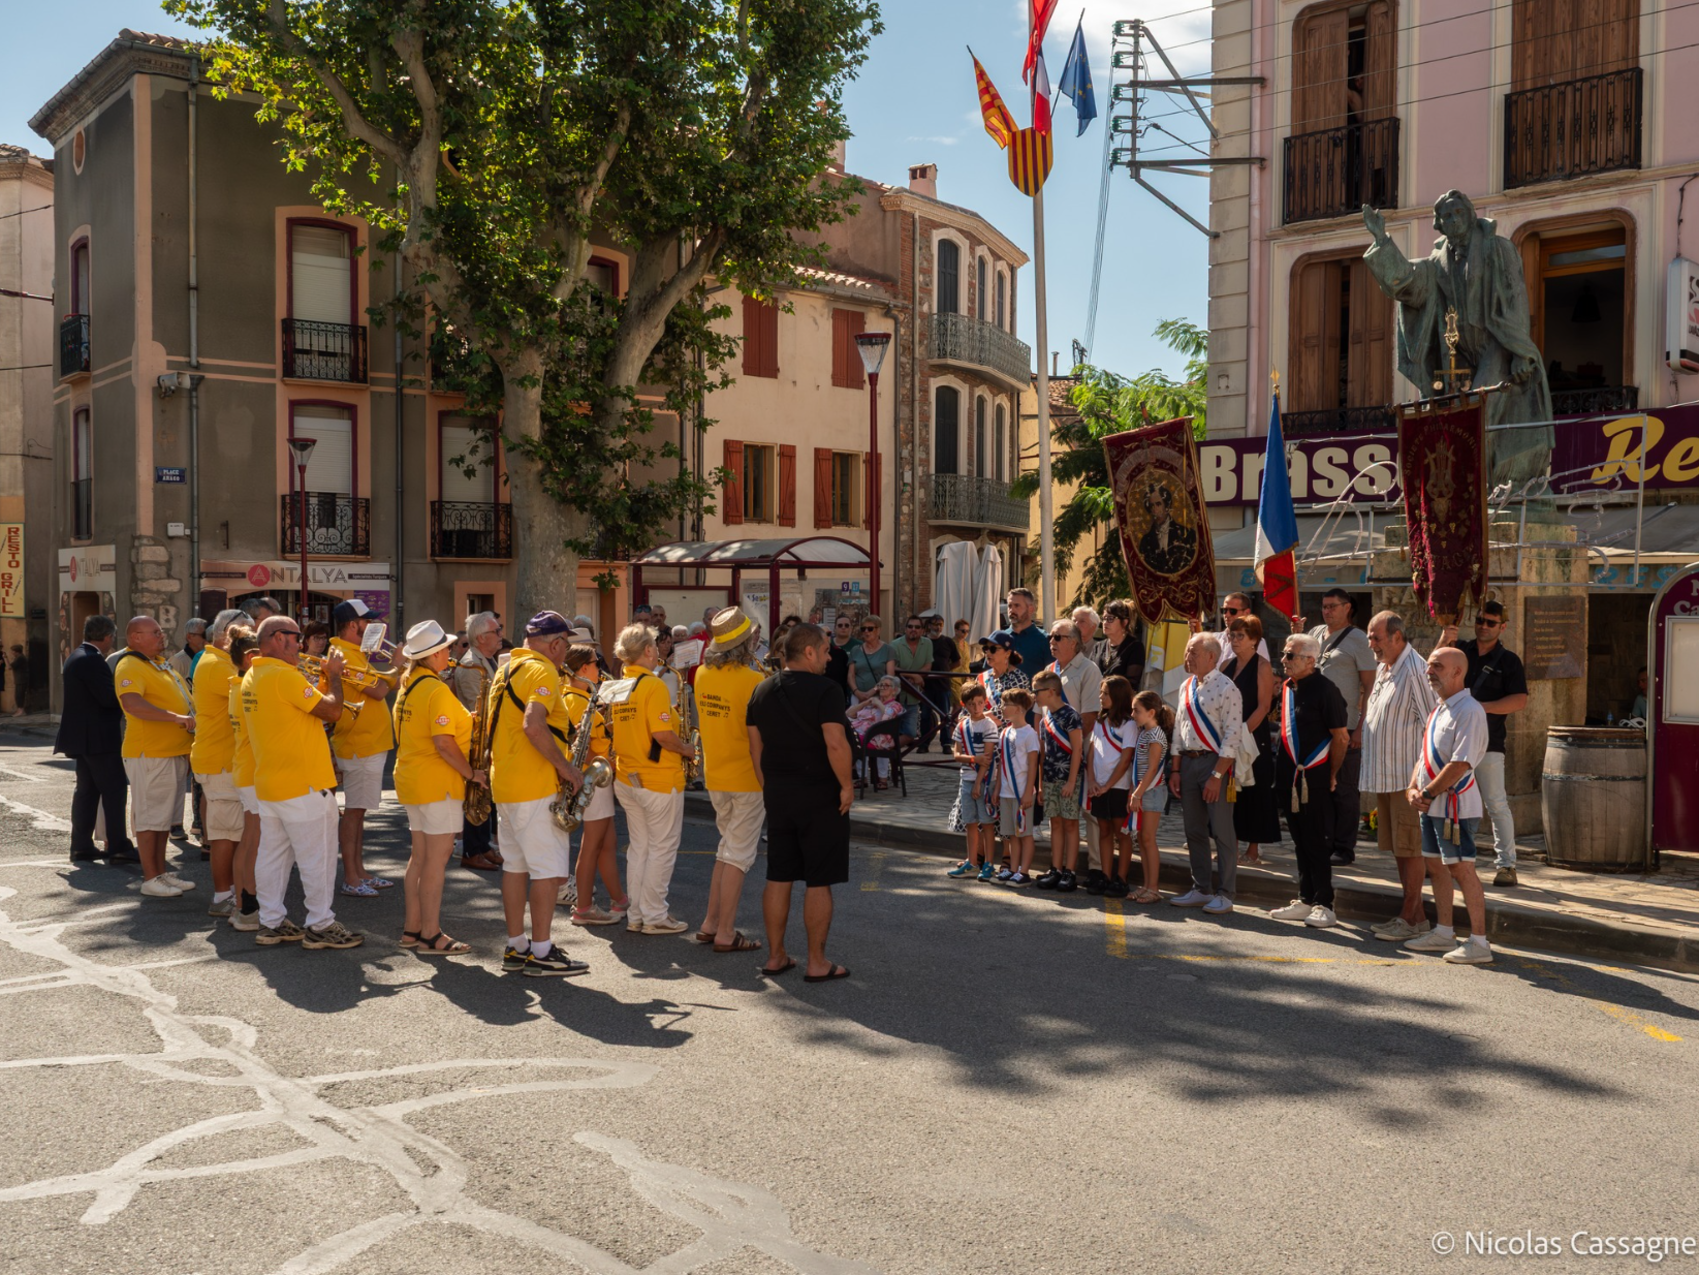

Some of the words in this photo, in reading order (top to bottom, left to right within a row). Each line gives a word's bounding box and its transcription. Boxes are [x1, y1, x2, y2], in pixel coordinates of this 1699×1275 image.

[7, 527, 20, 568] RESTO
[1, 573, 14, 613] GRILL
[248, 564, 348, 587] ANTALYA
